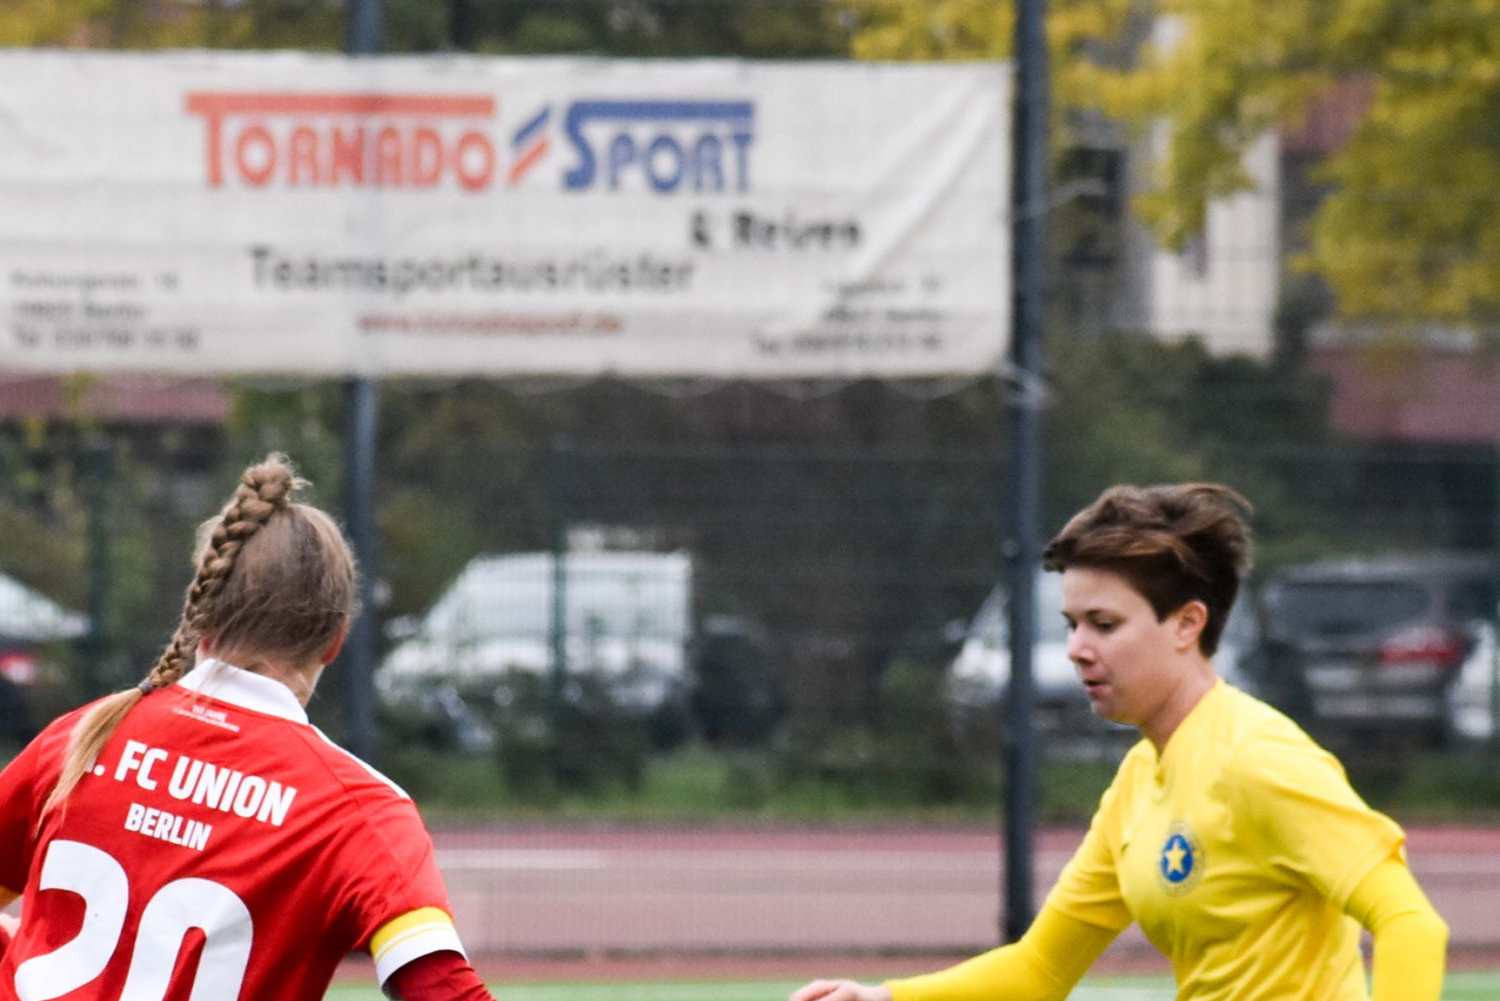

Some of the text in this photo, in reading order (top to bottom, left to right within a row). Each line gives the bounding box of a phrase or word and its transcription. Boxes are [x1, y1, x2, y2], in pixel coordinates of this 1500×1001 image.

[186, 92, 755, 192] TORNADO SPORT
[113, 738, 169, 791] FC
[168, 755, 297, 826] UNION
[124, 802, 212, 851] BERLIN
